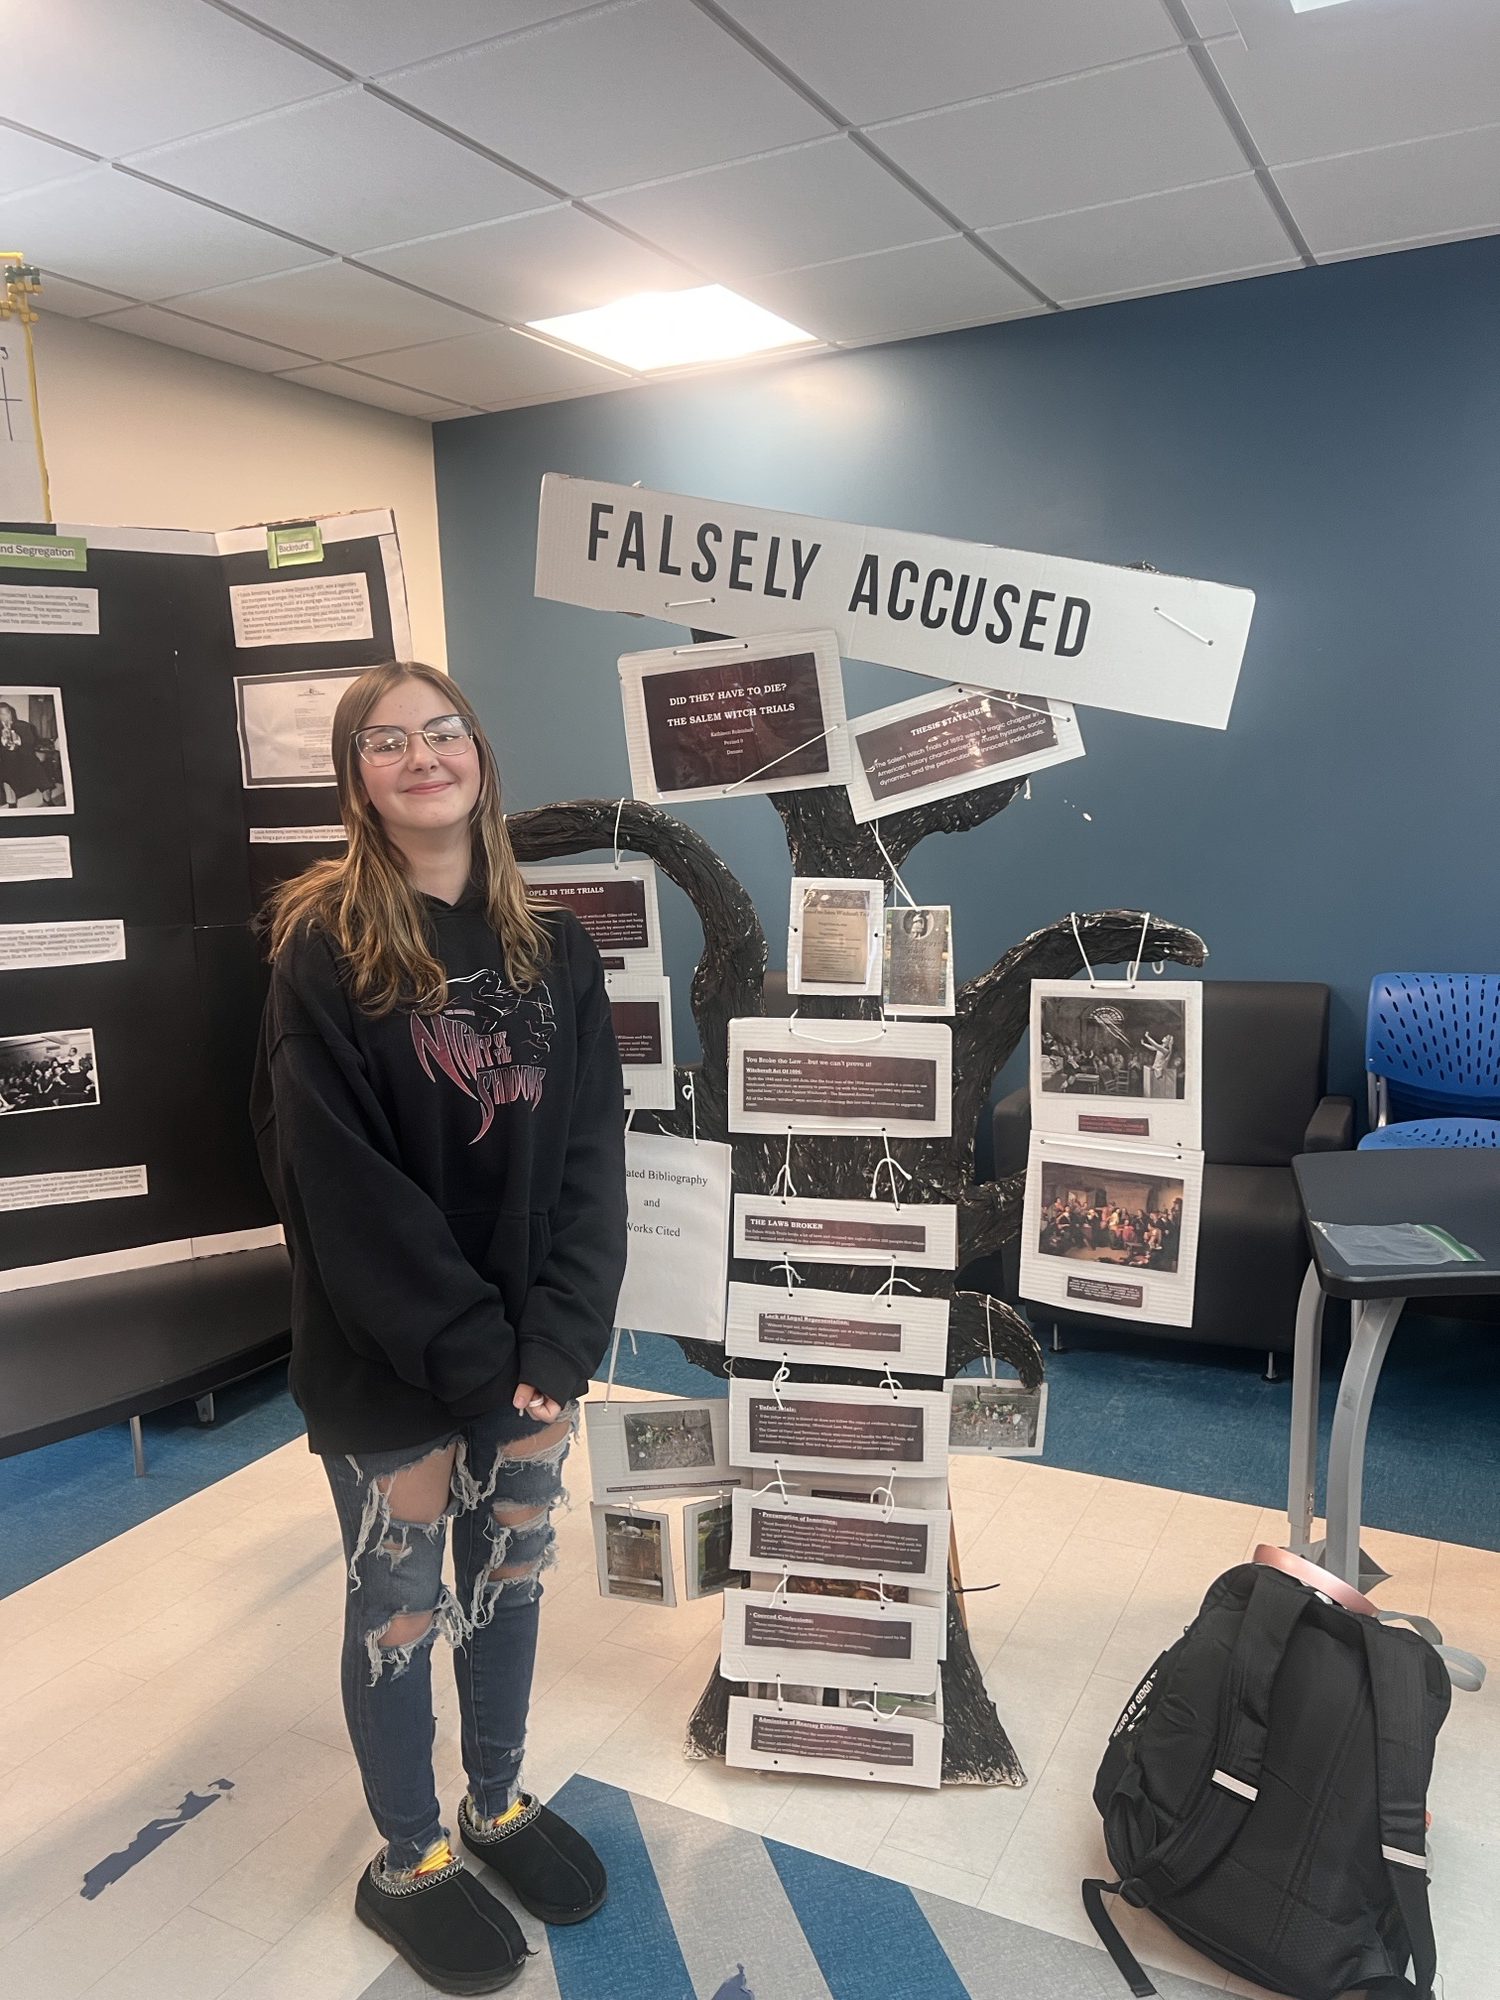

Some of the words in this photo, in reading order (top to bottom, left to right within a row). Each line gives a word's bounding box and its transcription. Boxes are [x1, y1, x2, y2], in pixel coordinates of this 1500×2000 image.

[0, 546, 13, 554] nd
[16, 546, 74, 557] Segregation
[587, 502, 822, 601] FALSELY
[847, 553, 1092, 658] ACCUSED
[670, 697, 686, 705] DID
[689, 693, 715, 703] THEY
[718, 689, 744, 699] HAVE
[747, 686, 760, 696] TO
[764, 683, 787, 694] DIE?
[668, 717, 687, 726] THE
[689, 713, 721, 724] SALEM
[725, 708, 756, 719] WITCH
[760, 703, 795, 715] TRIALS
[911, 722, 940, 736] THESIS
[940, 705, 989, 728] STATEME
[878, 764, 907, 777] American
[907, 757, 928, 767] history
[928, 742, 971, 760] characterized
[981, 734, 999, 743] mass
[1000, 726, 1026, 737] hysteria,
[1027, 718, 1046, 728] social
[887, 754, 906, 764] Salem
[907, 749, 925, 758] Witch
[926, 743, 942, 751] Trials
[965, 730, 980, 739] were
[987, 723, 1005, 732] tragic
[1007, 714, 1031, 725] chapter
[911, 767, 924, 775] and
[981, 740, 1008, 752] innocent
[1010, 729, 1044, 743] individuals.
[626, 1169, 645, 1179] ated
[648, 1170, 708, 1187] Bibliography
[643, 1198, 660, 1207] and
[656, 1225, 681, 1236] Cited
